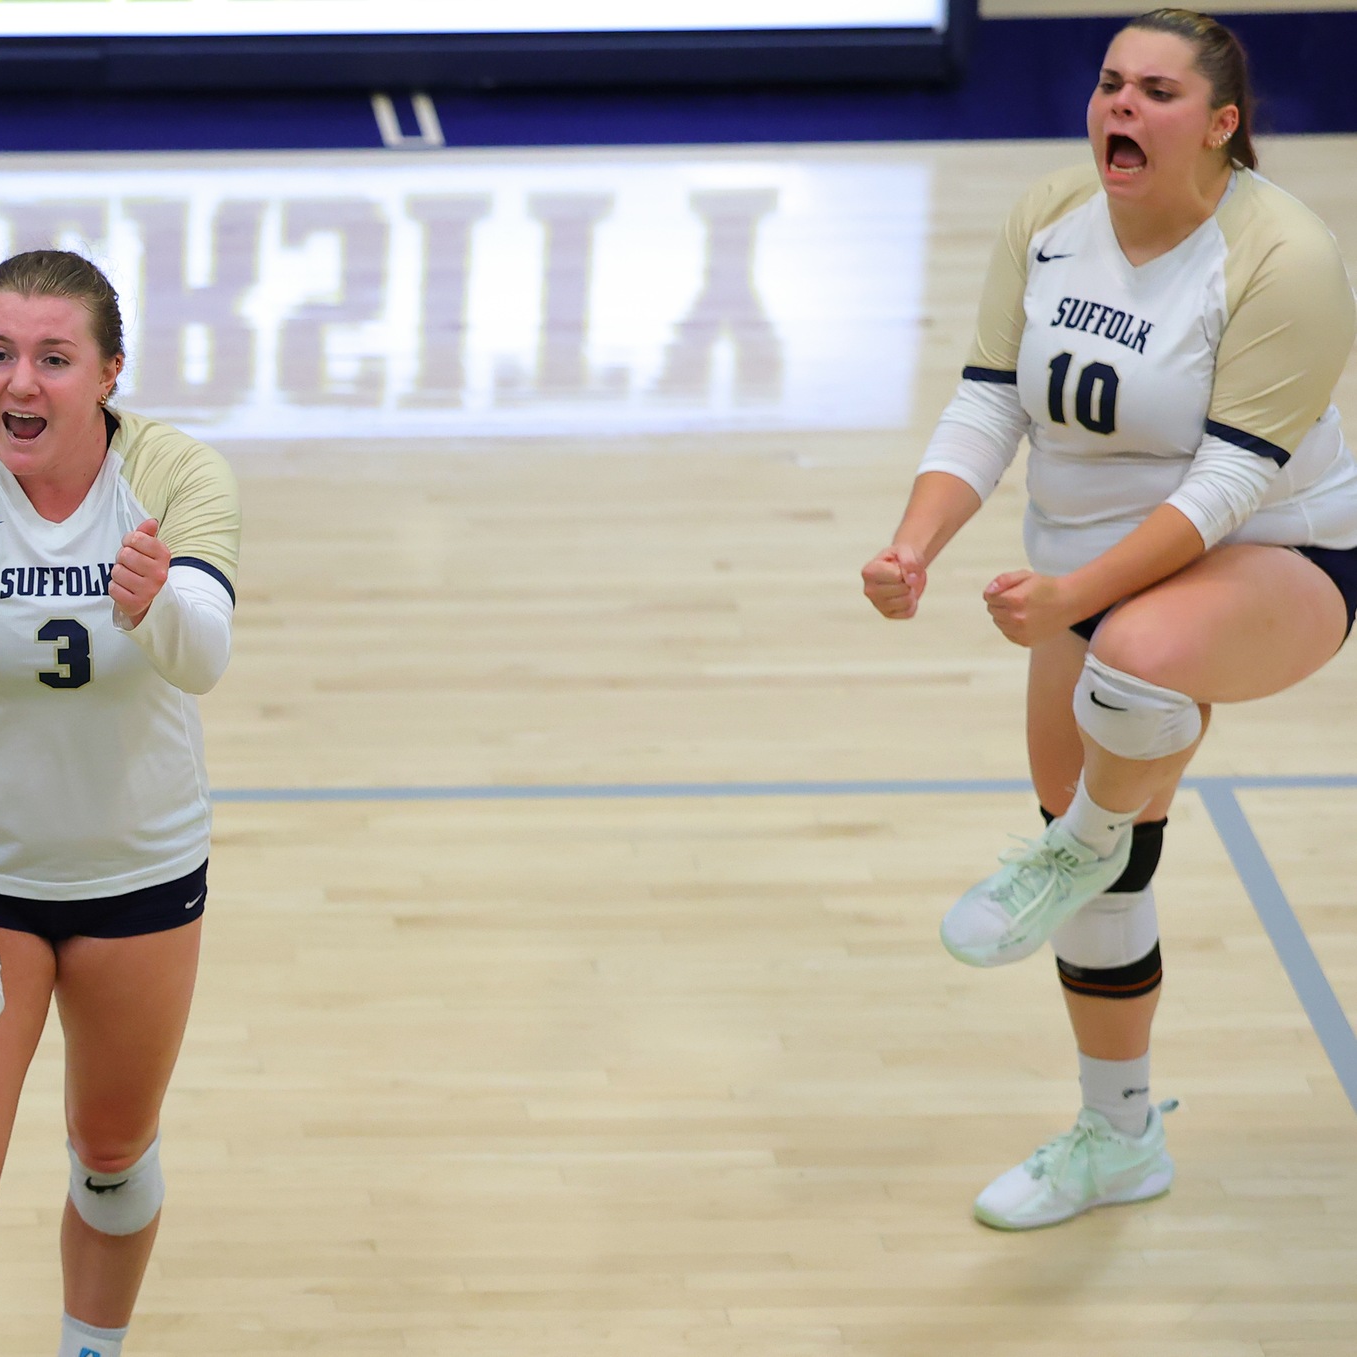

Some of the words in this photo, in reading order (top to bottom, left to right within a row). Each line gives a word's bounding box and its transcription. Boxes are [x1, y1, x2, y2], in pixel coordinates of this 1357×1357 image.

[1050, 297, 1155, 355] SUFFOLK
[1047, 351, 1120, 436] 10
[34, 616, 94, 691] 3
